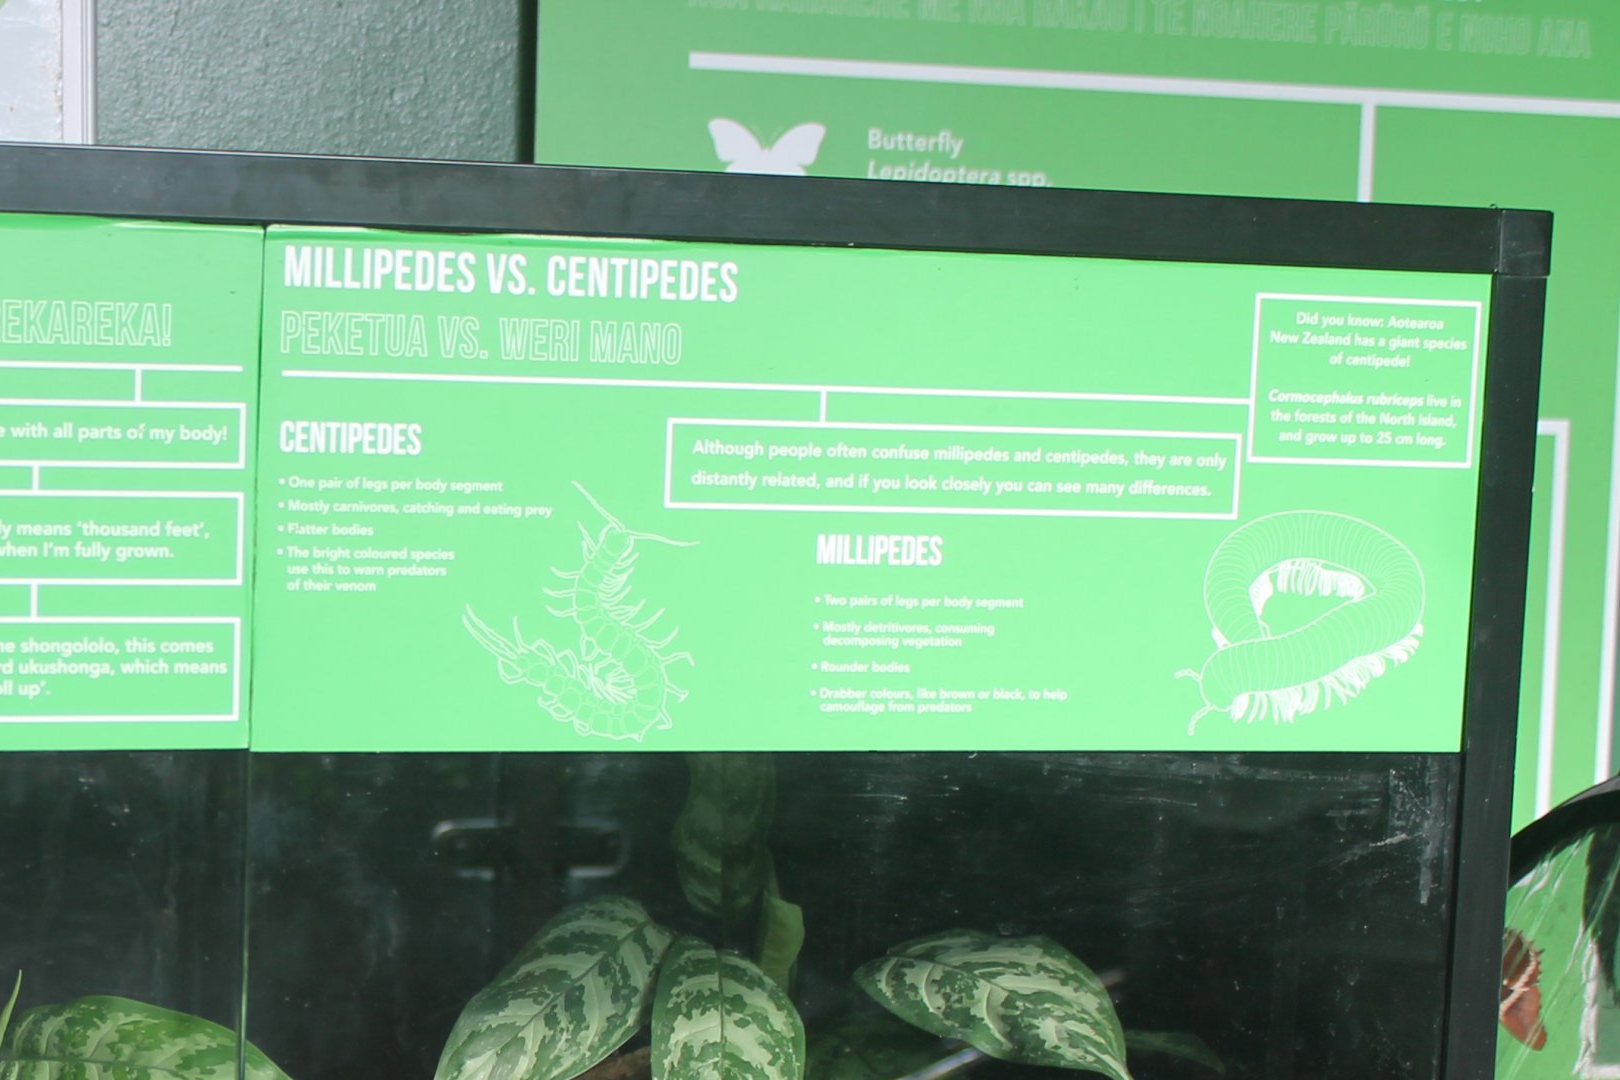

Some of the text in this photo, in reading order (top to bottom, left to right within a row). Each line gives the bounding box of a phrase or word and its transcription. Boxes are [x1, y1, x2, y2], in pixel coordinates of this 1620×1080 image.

[867, 128, 964, 159] Butterfly
[284, 244, 738, 302] MILLIPEDES VS. CENTIPEDES
[1296, 311, 1444, 329] Did you know: Aotearoa
[280, 310, 682, 365] PEKETUA VS. WERI MANO
[1270, 330, 1467, 351] New Zealand has a giant species
[1329, 351, 1410, 369] of centipede!
[10, 422, 48, 438] with
[53, 421, 72, 438] all
[78, 425, 122, 442] parts
[126, 423, 145, 439] of
[149, 428, 175, 444] my
[180, 424, 227, 444] body!
[280, 420, 422, 455] CENTIPEDES
[692, 439, 1227, 471] Although people often confuse millipedes and centipedes, they are only
[691, 469, 1211, 498] distantly related, and if you look closely you can see many differences.
[16, 524, 72, 536] means
[77, 520, 160, 536] 'thousand
[165, 520, 208, 538] feet',
[287, 522, 374, 535] Flatter bodies
[43, 542, 70, 557] I'm
[74, 540, 111, 561] fully
[115, 546, 174, 561] grown.
[816, 533, 943, 566] MILLIPEDES
[820, 660, 910, 672] Rounder bodies
